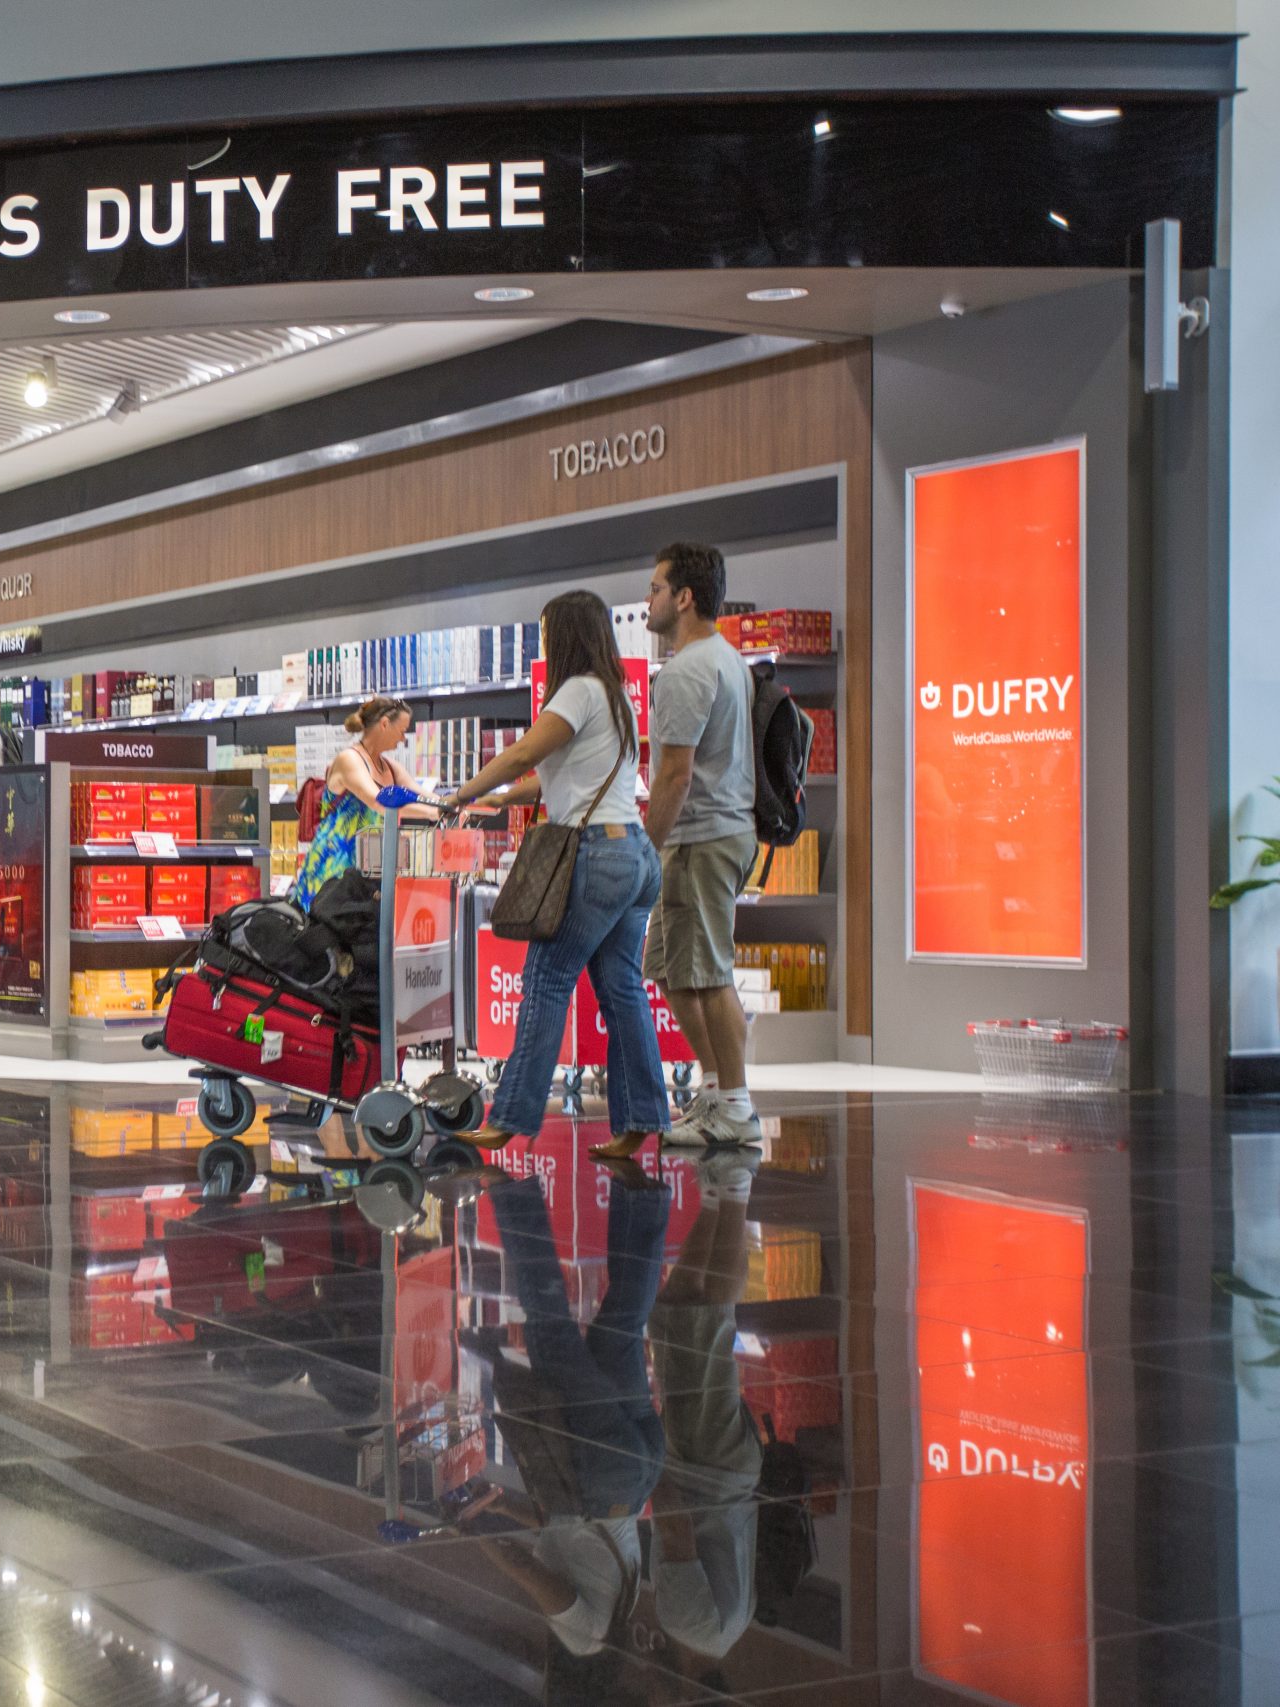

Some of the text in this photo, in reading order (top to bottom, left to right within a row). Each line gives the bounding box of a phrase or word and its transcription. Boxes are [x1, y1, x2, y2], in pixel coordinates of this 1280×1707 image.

[86, 173, 292, 253] DUTY
[337, 160, 545, 236] FREE
[548, 424, 665, 481] TOBACCO
[952, 674, 1074, 719] DUFRY
[102, 743, 154, 758] TOBACCO
[405, 965, 443, 990] HanaTour
